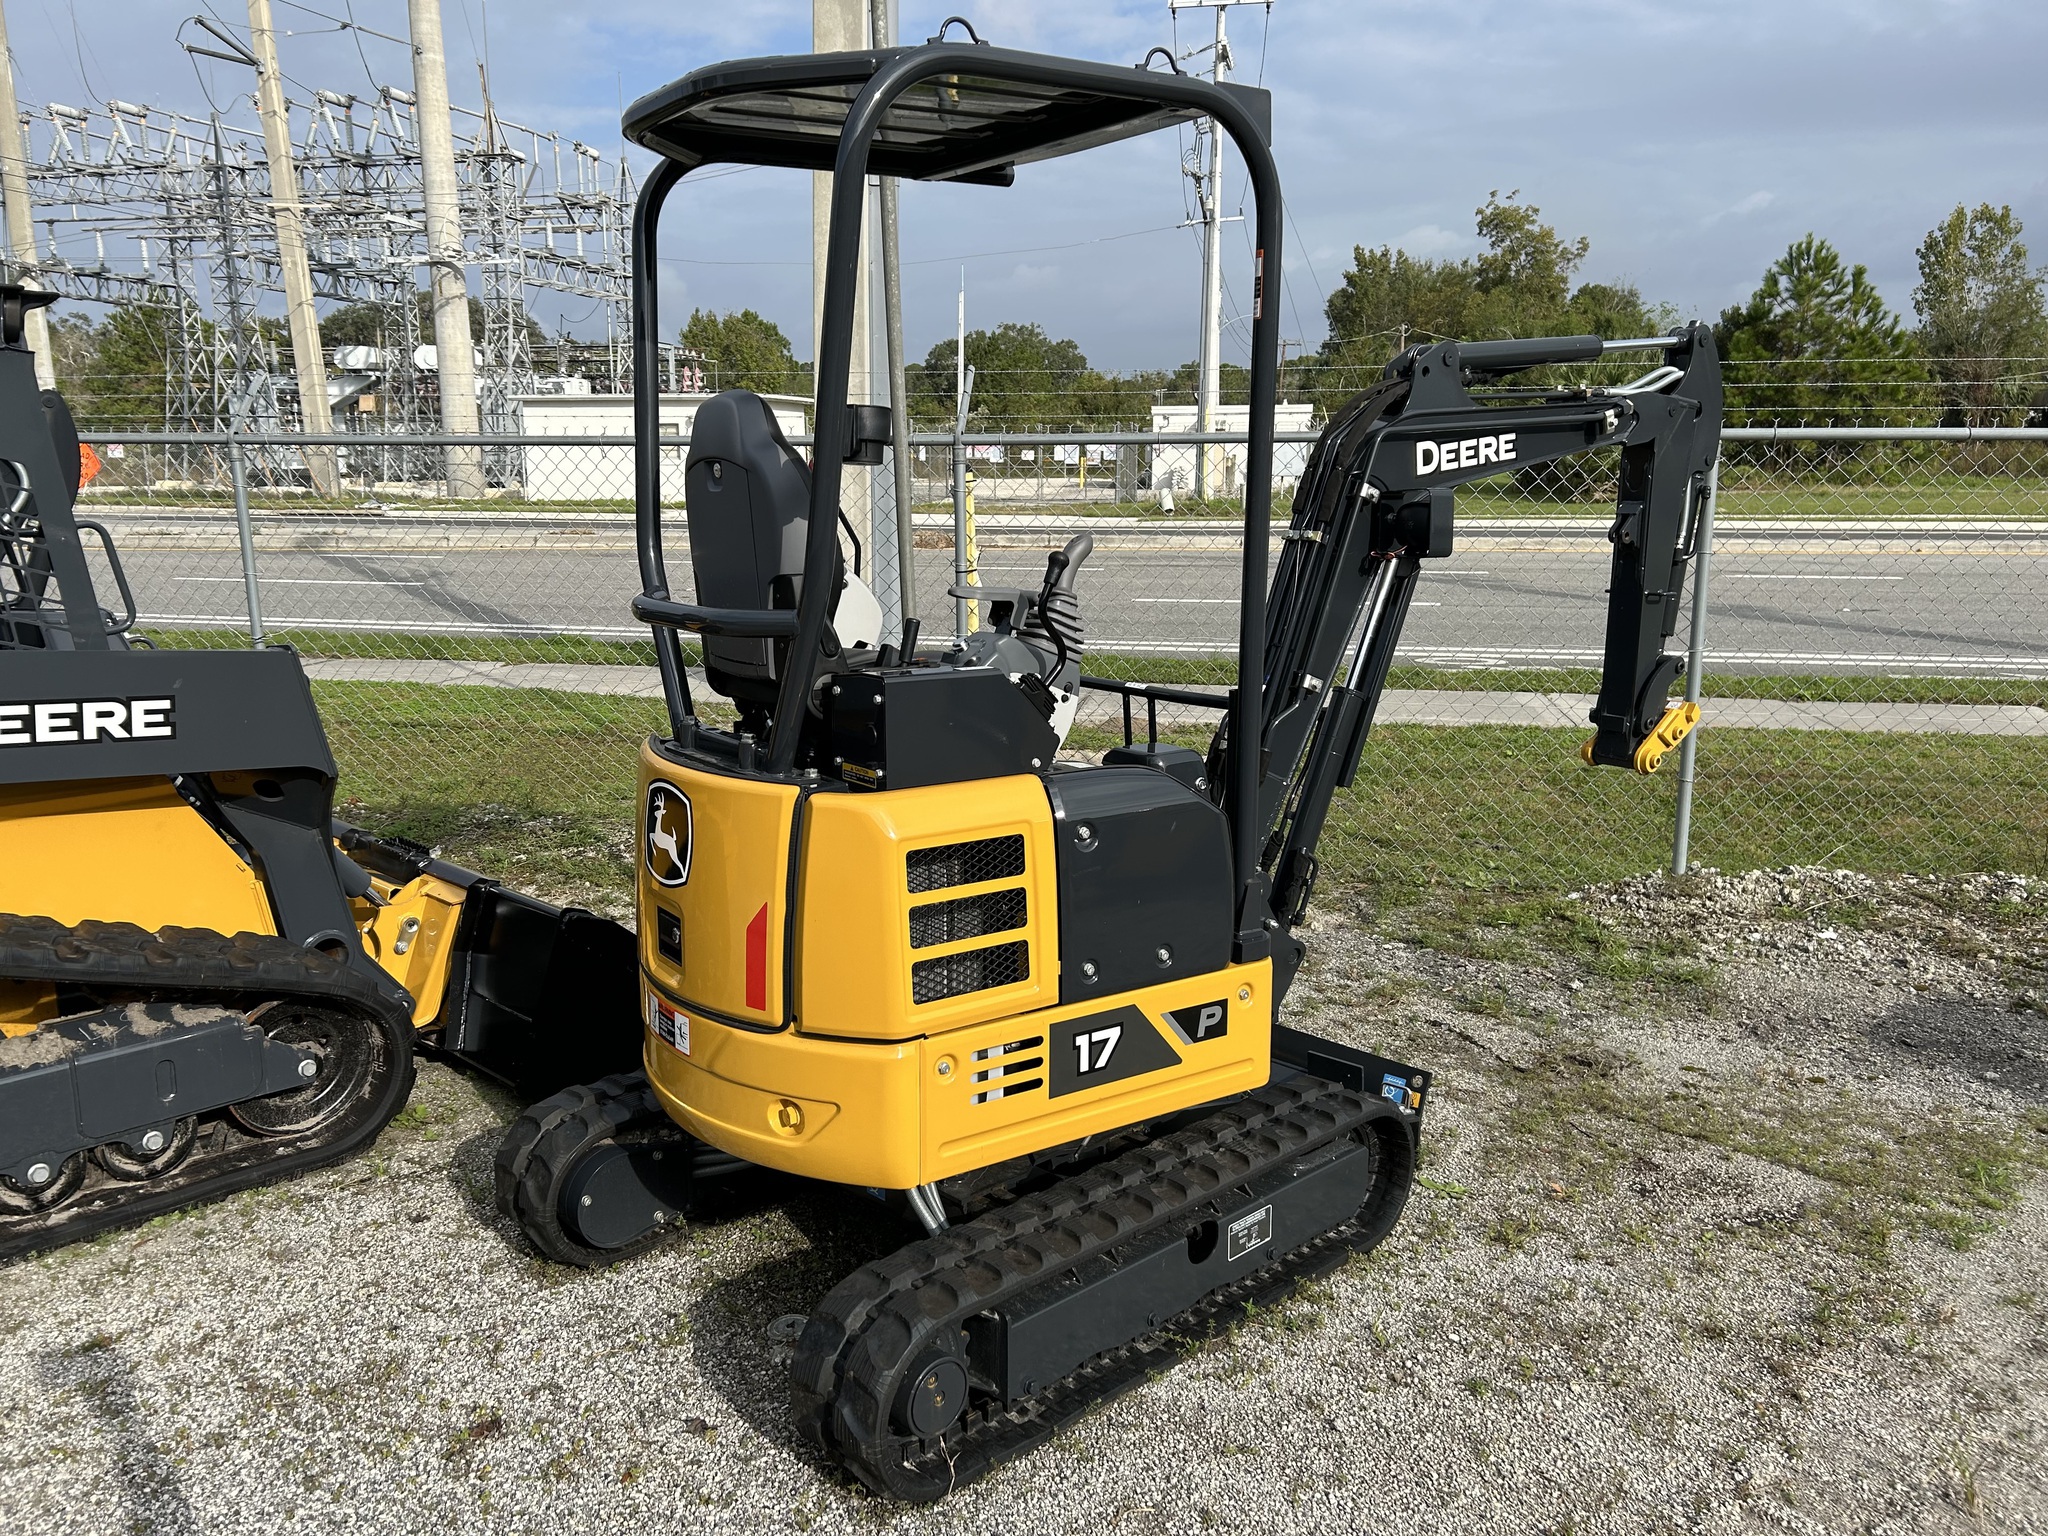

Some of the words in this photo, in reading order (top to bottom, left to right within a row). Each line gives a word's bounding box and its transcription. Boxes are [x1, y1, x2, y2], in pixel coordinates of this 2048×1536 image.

[1416, 432, 1516, 476] DEERE
[1196, 1005, 1223, 1039] P
[1075, 1025, 1122, 1073] 17
